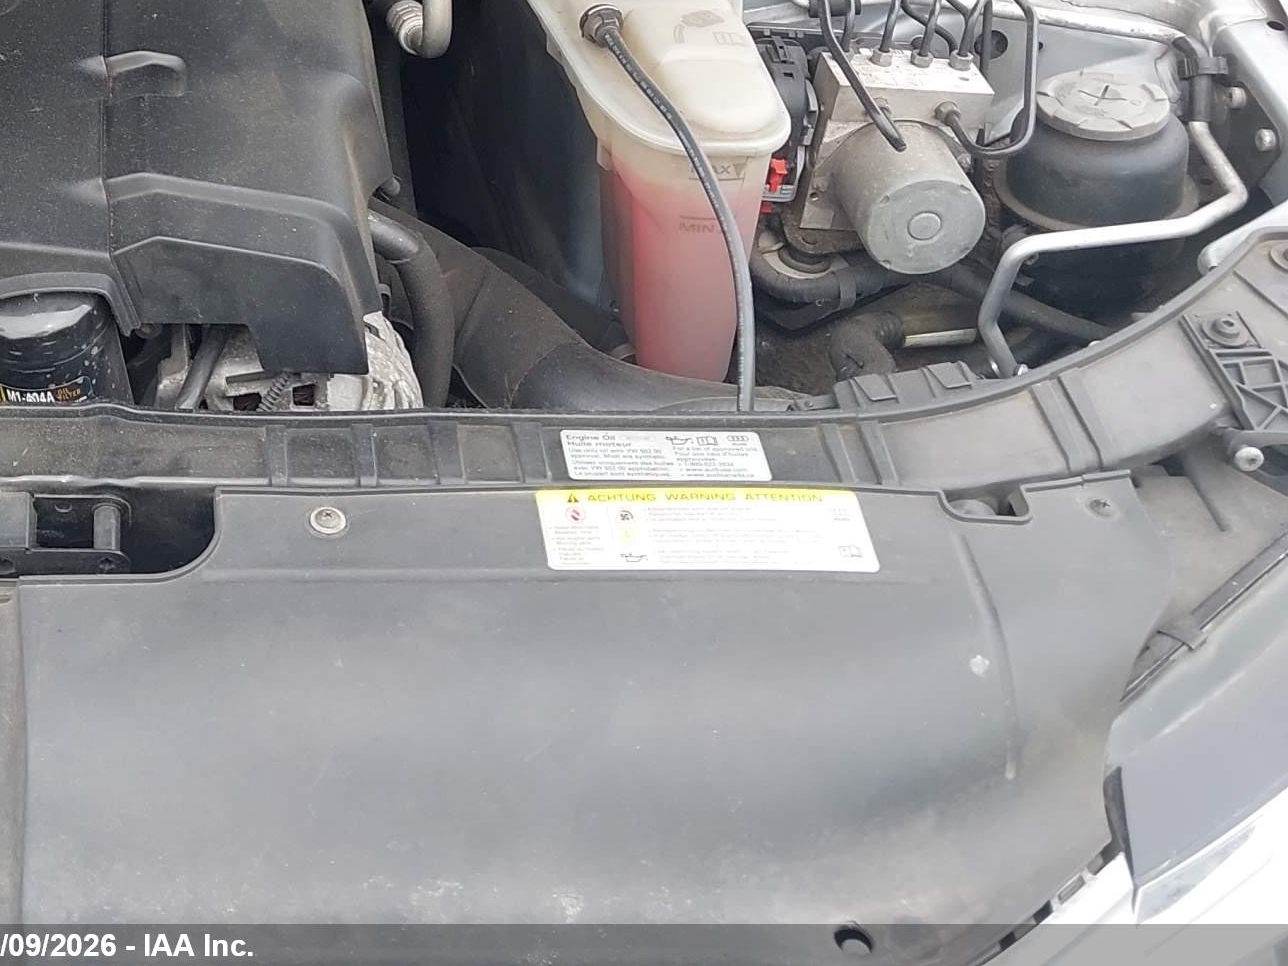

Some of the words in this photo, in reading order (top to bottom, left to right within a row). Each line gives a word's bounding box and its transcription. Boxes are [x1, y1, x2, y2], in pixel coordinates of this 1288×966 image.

[679, 222, 715, 233] MIN
[587, 493, 657, 502] ACHTUNG
[664, 493, 737, 502] WARNING
[745, 493, 823, 503] ATTENTION
